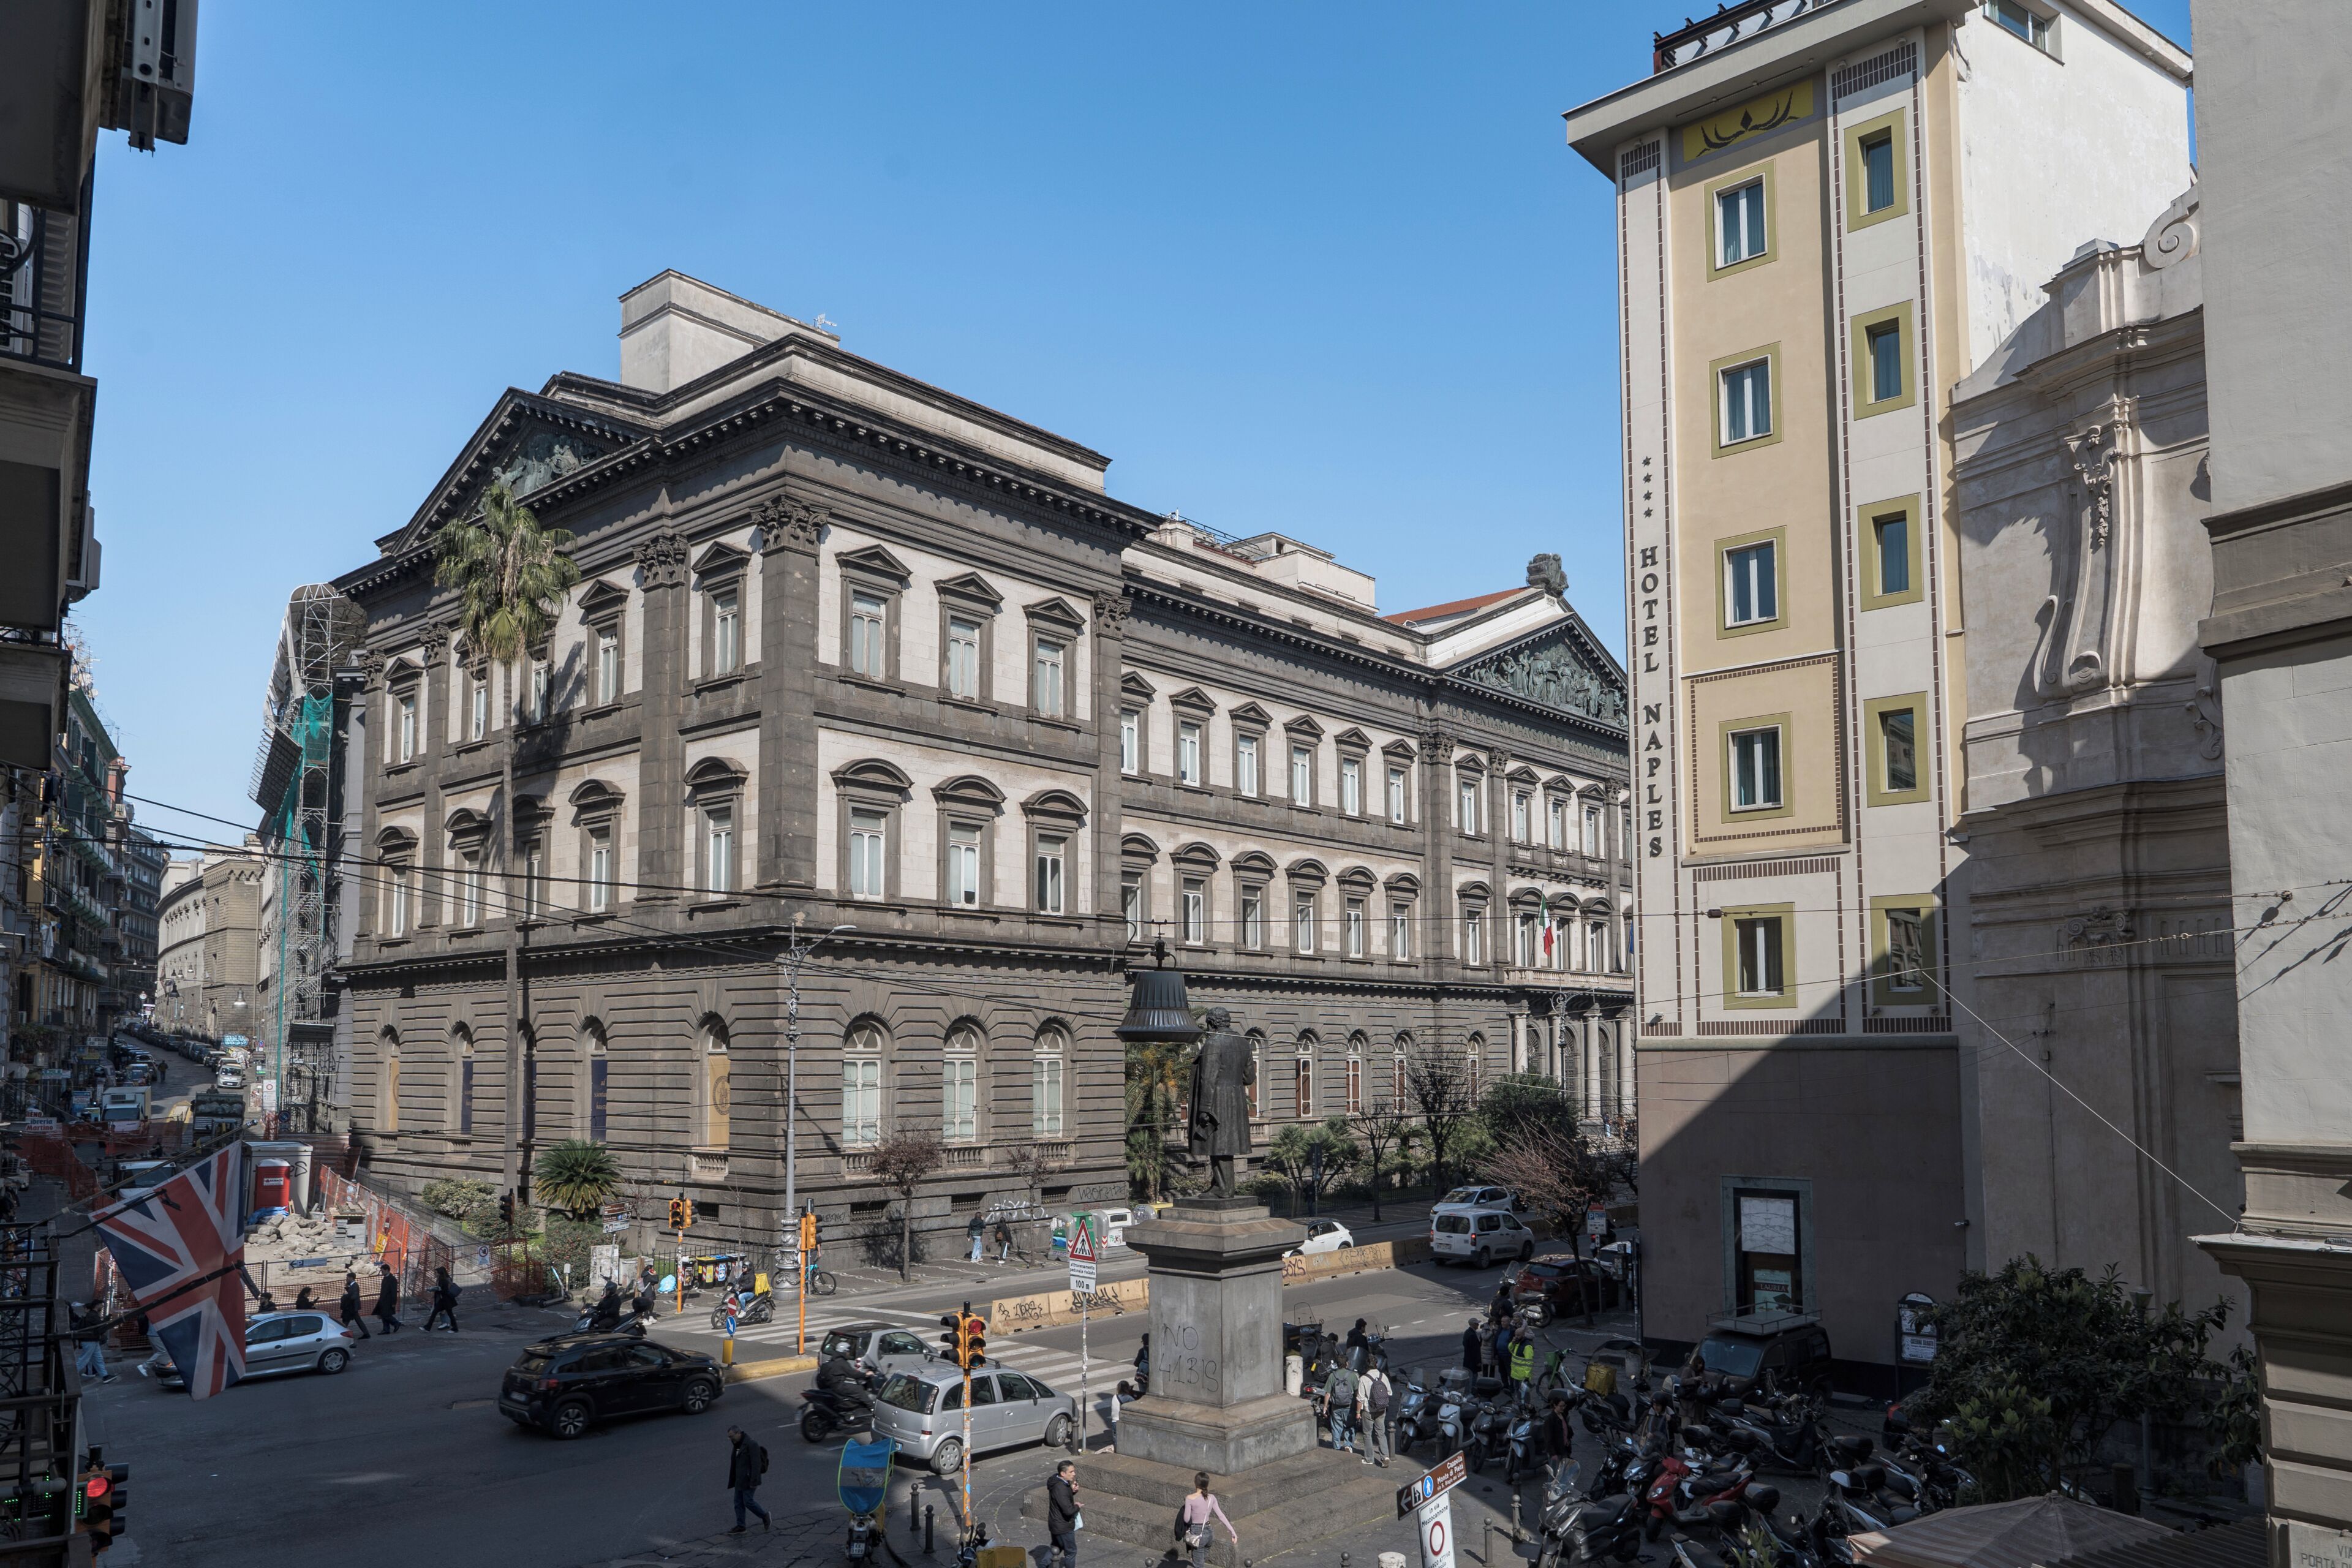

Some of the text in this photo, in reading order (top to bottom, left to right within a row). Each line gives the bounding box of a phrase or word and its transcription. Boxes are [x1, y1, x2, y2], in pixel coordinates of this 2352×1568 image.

[1640, 545, 1664, 858] HOTEL NAPLES
[1076, 1279, 1085, 1289] 100
[1760, 1283, 1785, 1292] LAUREA
[1163, 1323, 1199, 1351] NO
[1447, 1455, 1463, 1469] Cappella
[1437, 1472, 1449, 1484] Monte
[1421, 1505, 1449, 1528] Mezzocannone
[1439, 1550, 1450, 1563] ATTIVO
